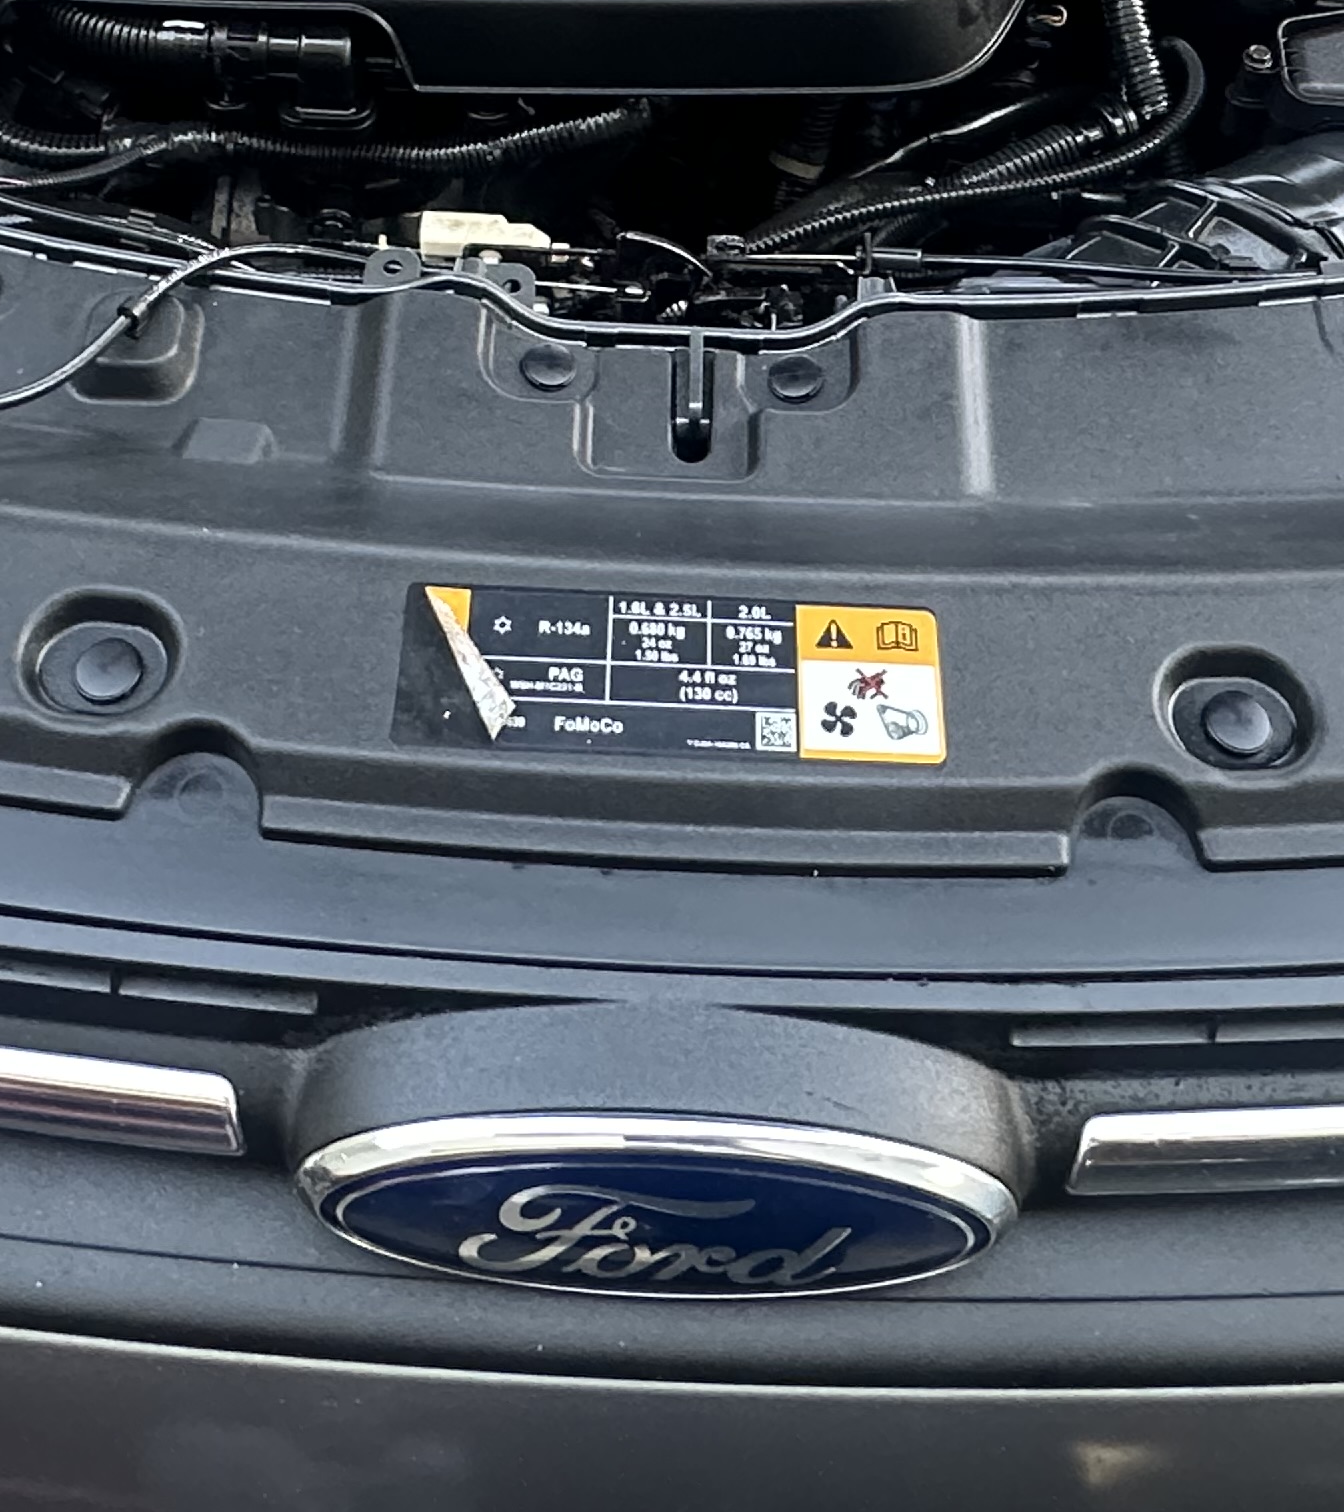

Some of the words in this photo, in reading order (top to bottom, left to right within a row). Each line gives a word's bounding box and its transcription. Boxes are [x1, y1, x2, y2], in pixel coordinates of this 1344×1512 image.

[668, 601, 702, 618] 2.5L
[738, 604, 772, 620] 2.0L
[538, 620, 591, 636] R-134a
[667, 622, 686, 640] kg
[764, 627, 782, 645] kg
[548, 666, 584, 682] PAG
[678, 670, 702, 684] 4.4
[717, 673, 738, 686] oz
[553, 715, 625, 734] FoMoCo
[459, 1185, 852, 1283] Ford
